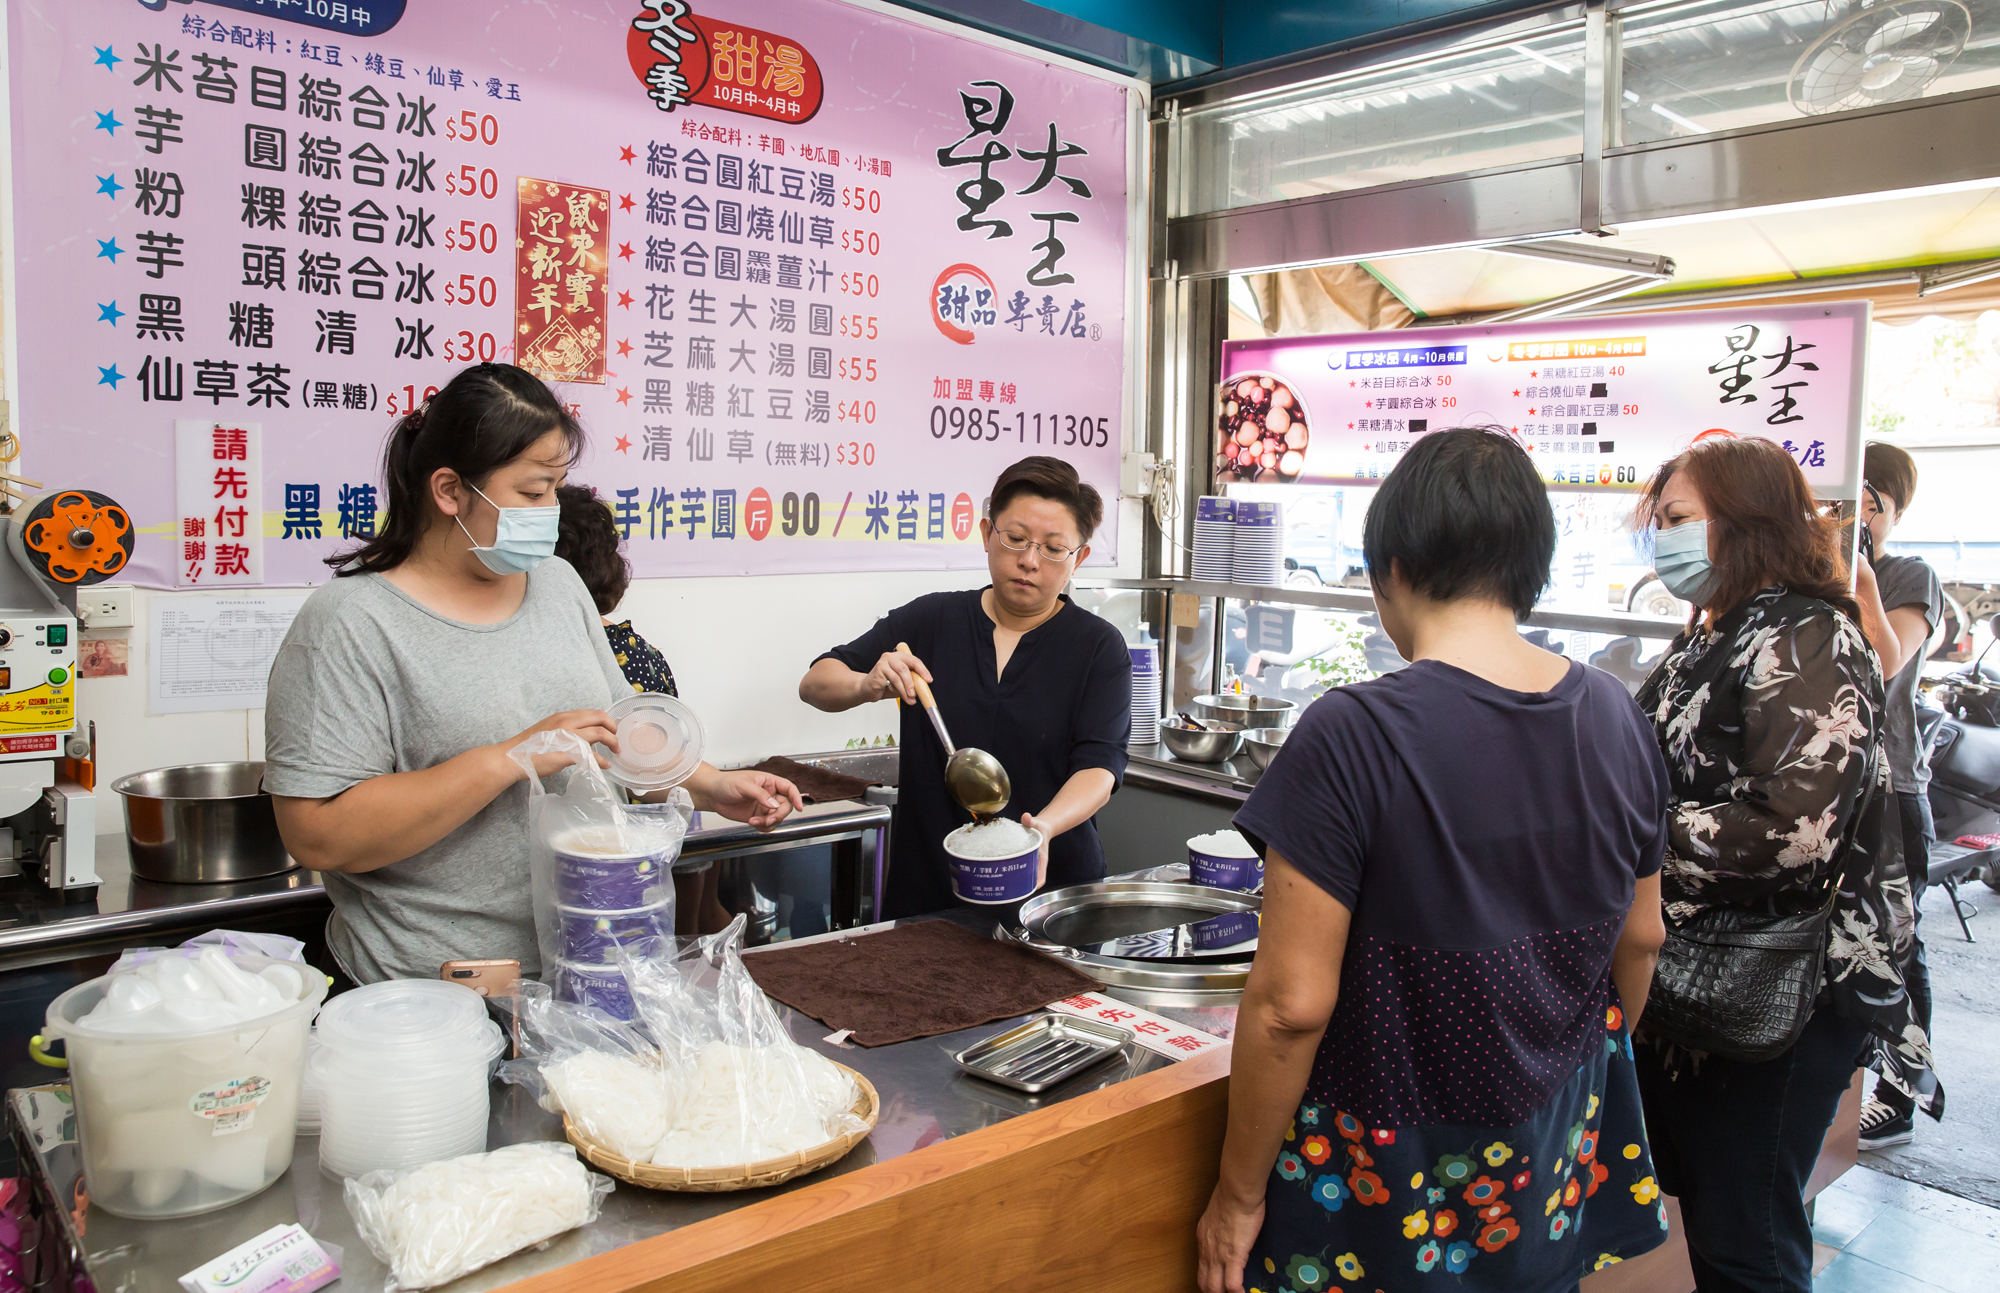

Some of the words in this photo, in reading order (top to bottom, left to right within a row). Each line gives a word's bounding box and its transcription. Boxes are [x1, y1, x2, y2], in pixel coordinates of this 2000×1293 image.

[632, 0, 698, 112] 冬季
[713, 31, 805, 97] 甜湯
[133, 42, 437, 138] 米苔目綜合冰
[444, 112, 499, 146] $50
[713, 85, 800, 117] 10月中~4月中
[444, 166, 498, 200] $50
[646, 140, 836, 209] 綜合圓紅豆湯
[842, 187, 881, 214] $50
[443, 221, 497, 254] $50
[645, 188, 835, 249] 綜合圓燒仙草
[841, 229, 880, 256] $50
[527, 206, 565, 324] 迎新年
[443, 275, 497, 308] $50
[840, 272, 879, 299] $50
[644, 284, 833, 337] 花生大湯圓
[839, 315, 879, 341] $55
[938, 285, 997, 326] 甜品
[1004, 290, 1086, 338] 專賣店
[442, 329, 497, 364] $30
[643, 331, 833, 381] 芝麻大湯圓
[838, 358, 878, 383] $55
[1361, 375, 1432, 389] 米苔目綜合冰
[1437, 375, 1452, 386] 50
[1542, 366, 1605, 379] 黑糖紅豆湯
[1609, 366, 1625, 376] 40
[642, 378, 831, 425] 黑糖紅豆湯
[837, 400, 877, 425] $40
[933, 376, 1017, 404] 加盟專線
[1375, 397, 1437, 410] 芋圓綜合冰
[1442, 397, 1457, 407] 50
[1525, 385, 1586, 399] 綜合燒仙草
[930, 405, 1108, 447] 0985-111305
[1358, 419, 1405, 431] 黑糖清冰
[1541, 404, 1619, 417] 綜合圓紅豆湯
[1622, 405, 1639, 415] 50
[1523, 423, 1579, 436] 花生湯圓
[836, 442, 876, 467] $30
[1553, 463, 1596, 484] 米苔目
[1617, 465, 1636, 484] 60
[213, 427, 251, 577] 請先付款
[614, 486, 737, 540] 手作芋圓
[782, 491, 820, 537] 90
[865, 489, 945, 541] 米苔目
[1061, 995, 1210, 1051] 請先付款
